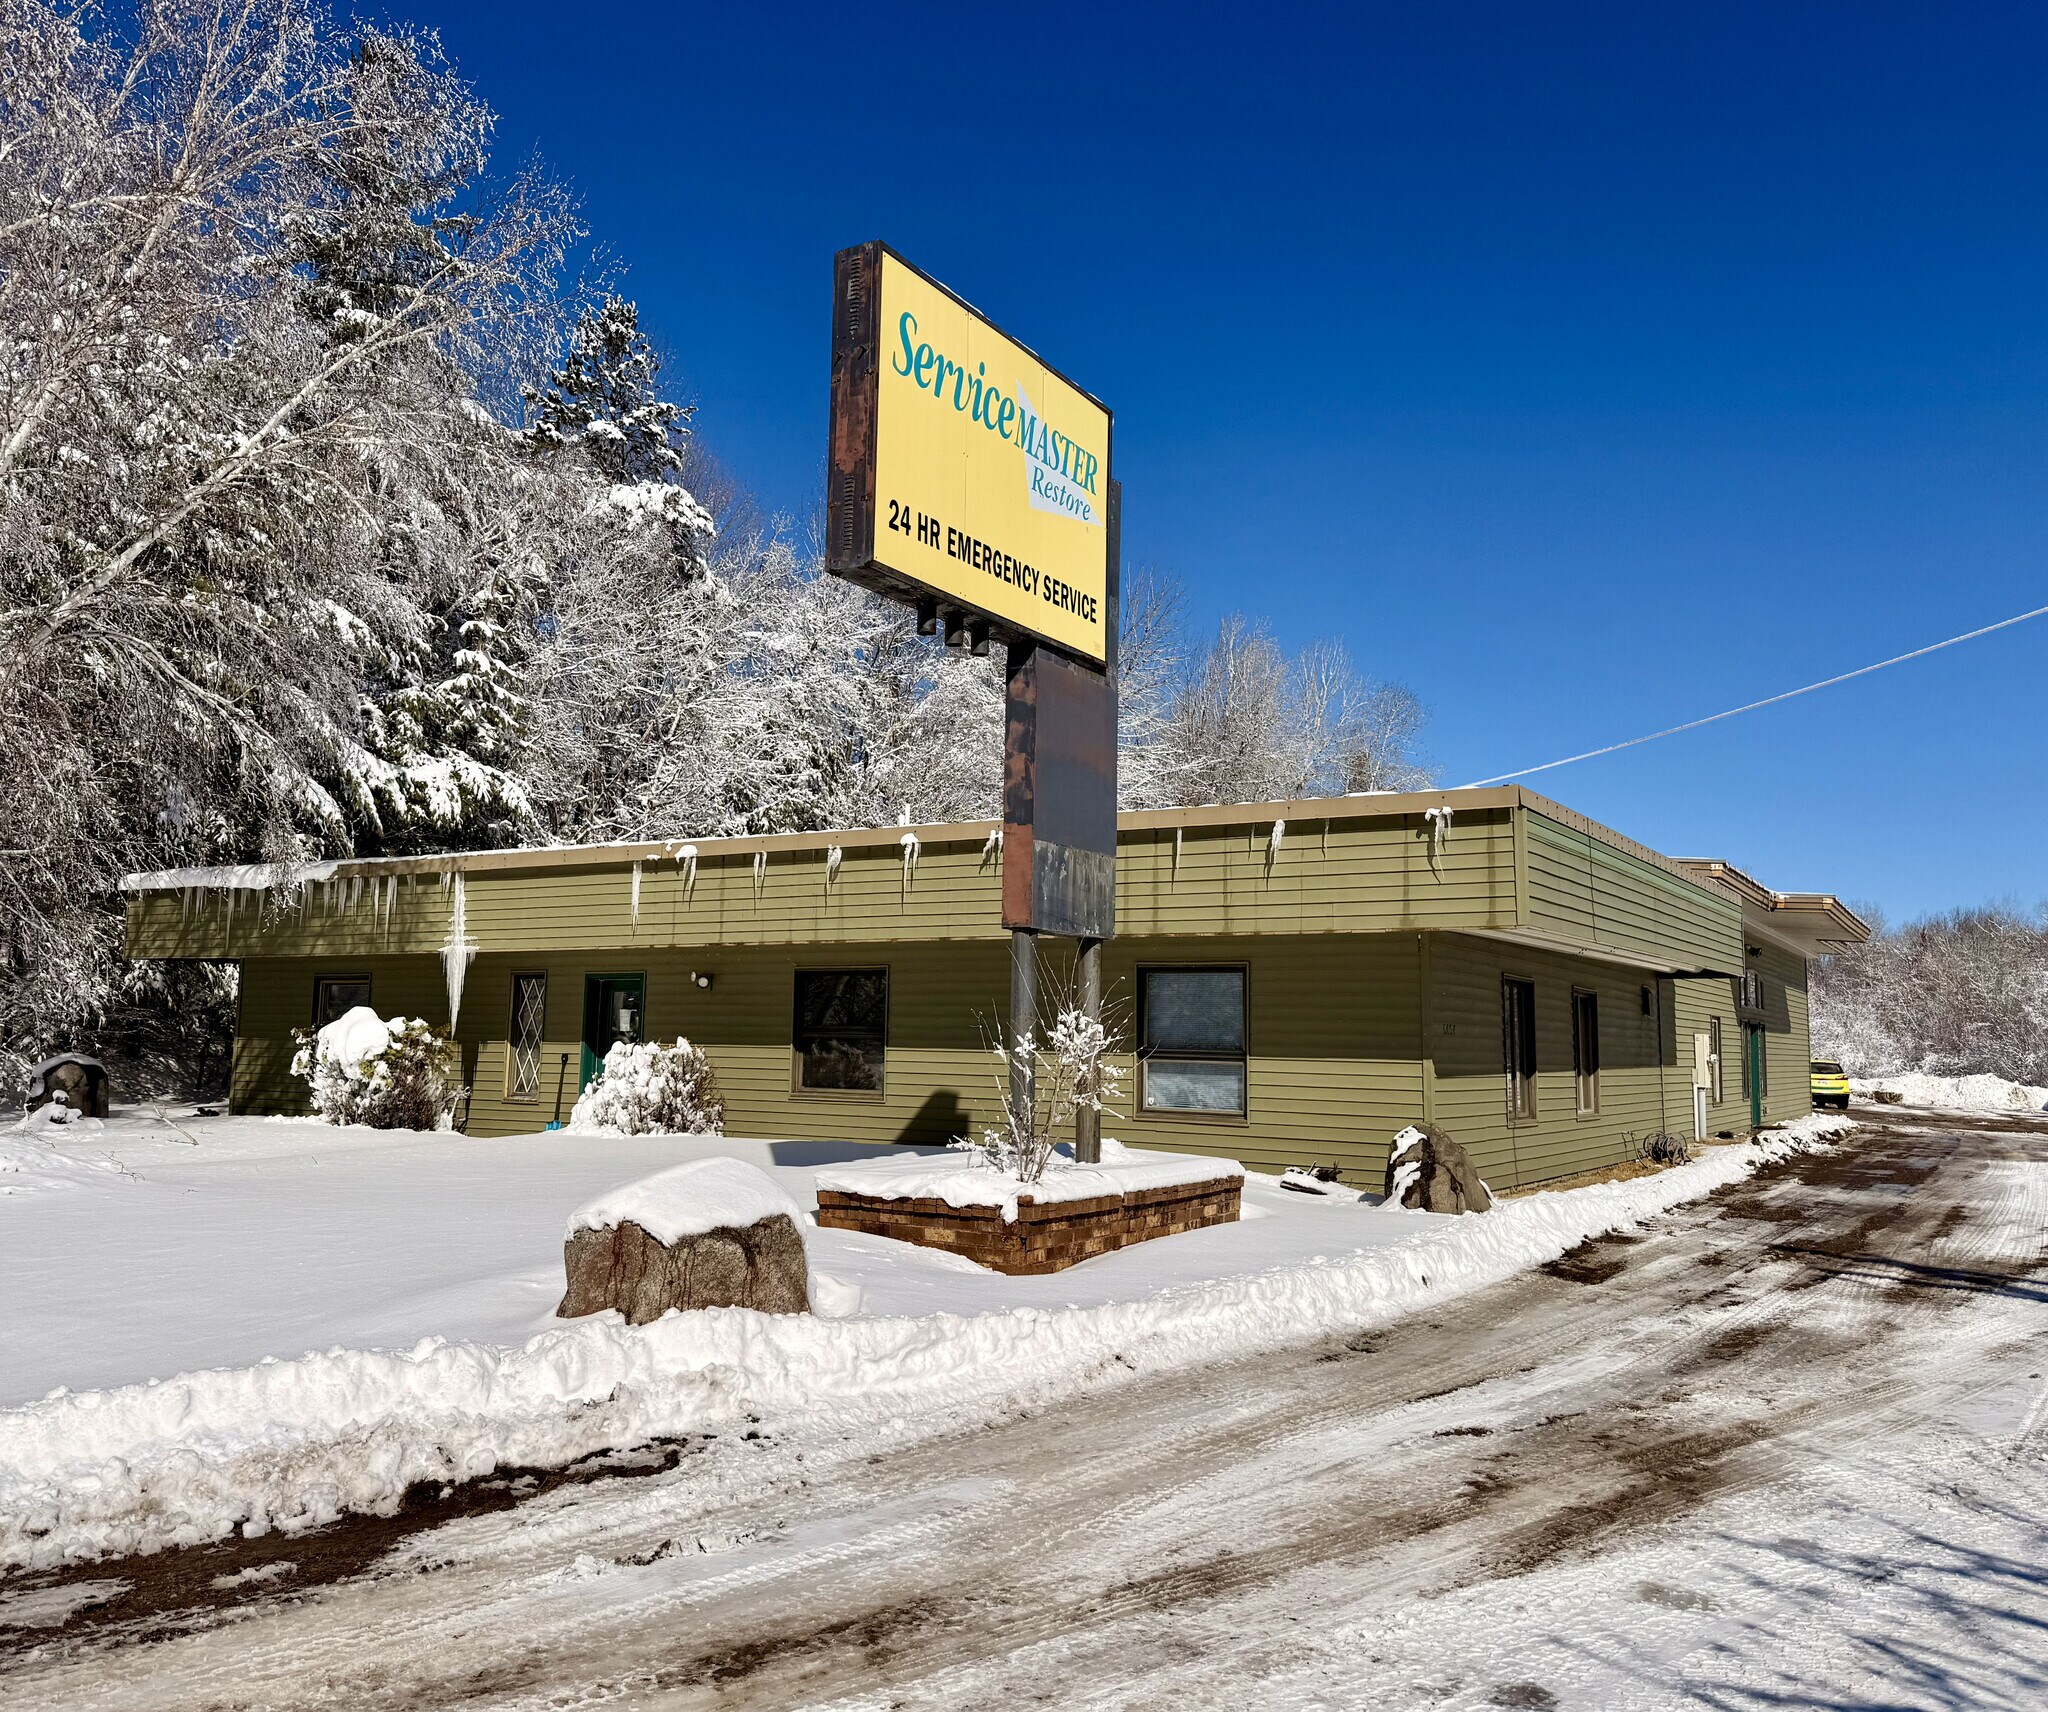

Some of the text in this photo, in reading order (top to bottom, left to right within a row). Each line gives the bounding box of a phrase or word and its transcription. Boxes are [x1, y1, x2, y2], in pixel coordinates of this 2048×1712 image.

[1031, 465, 1091, 521] Restore
[888, 499, 1097, 625] 24 HR EMERGENCY SERVICE
